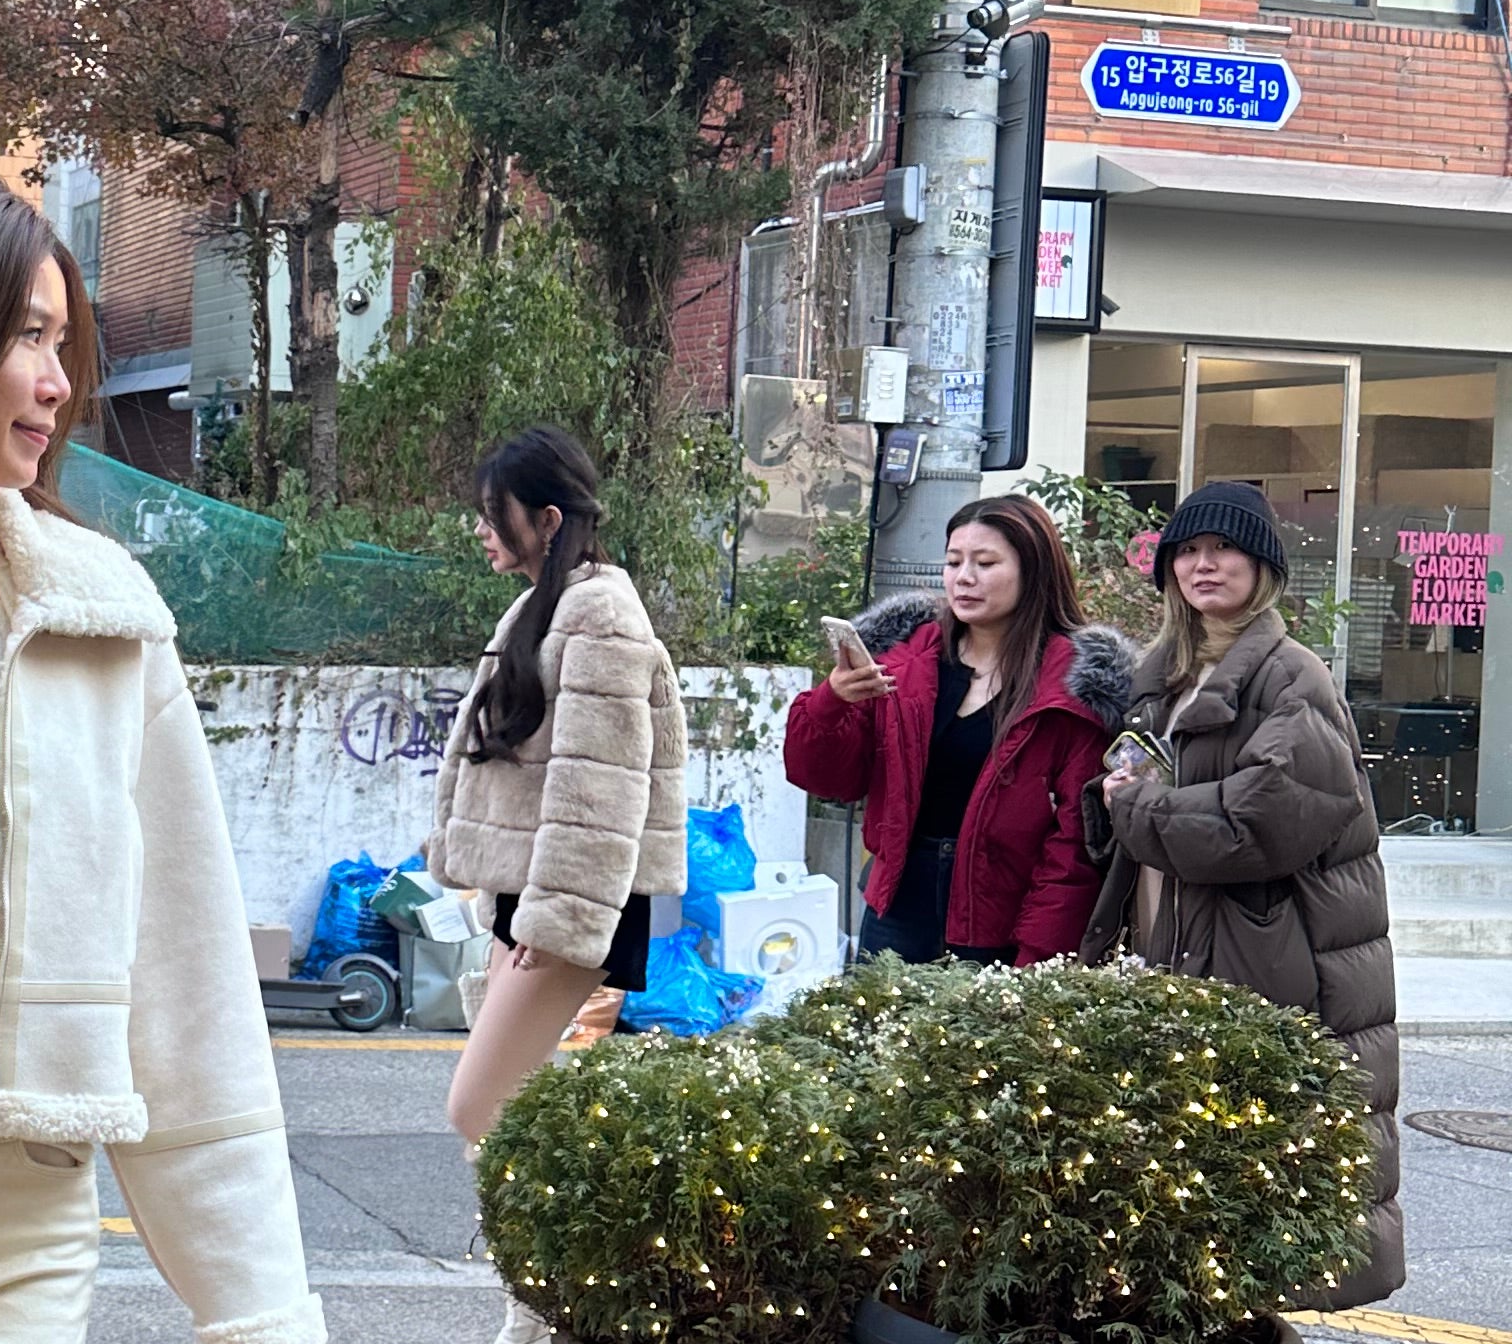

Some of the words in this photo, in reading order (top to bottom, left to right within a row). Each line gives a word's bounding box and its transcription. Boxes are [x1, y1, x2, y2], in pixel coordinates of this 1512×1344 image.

[1101, 66, 1120, 87] 15
[1126, 56, 1255, 94] 압구정로56길
[1259, 79, 1279, 101] 19
[1120, 89, 1213, 114] Apgujeong-ro
[1218, 97, 1259, 118] 56-gil
[1037, 232, 1074, 245] ORARY
[1039, 245, 1062, 258] DEN
[1037, 260, 1063, 273] WER
[1397, 531, 1505, 556] TEMPORARY
[1414, 556, 1487, 579] GARDEN
[1412, 579, 1488, 603] FLOWER
[1409, 602, 1487, 626] MARKET
